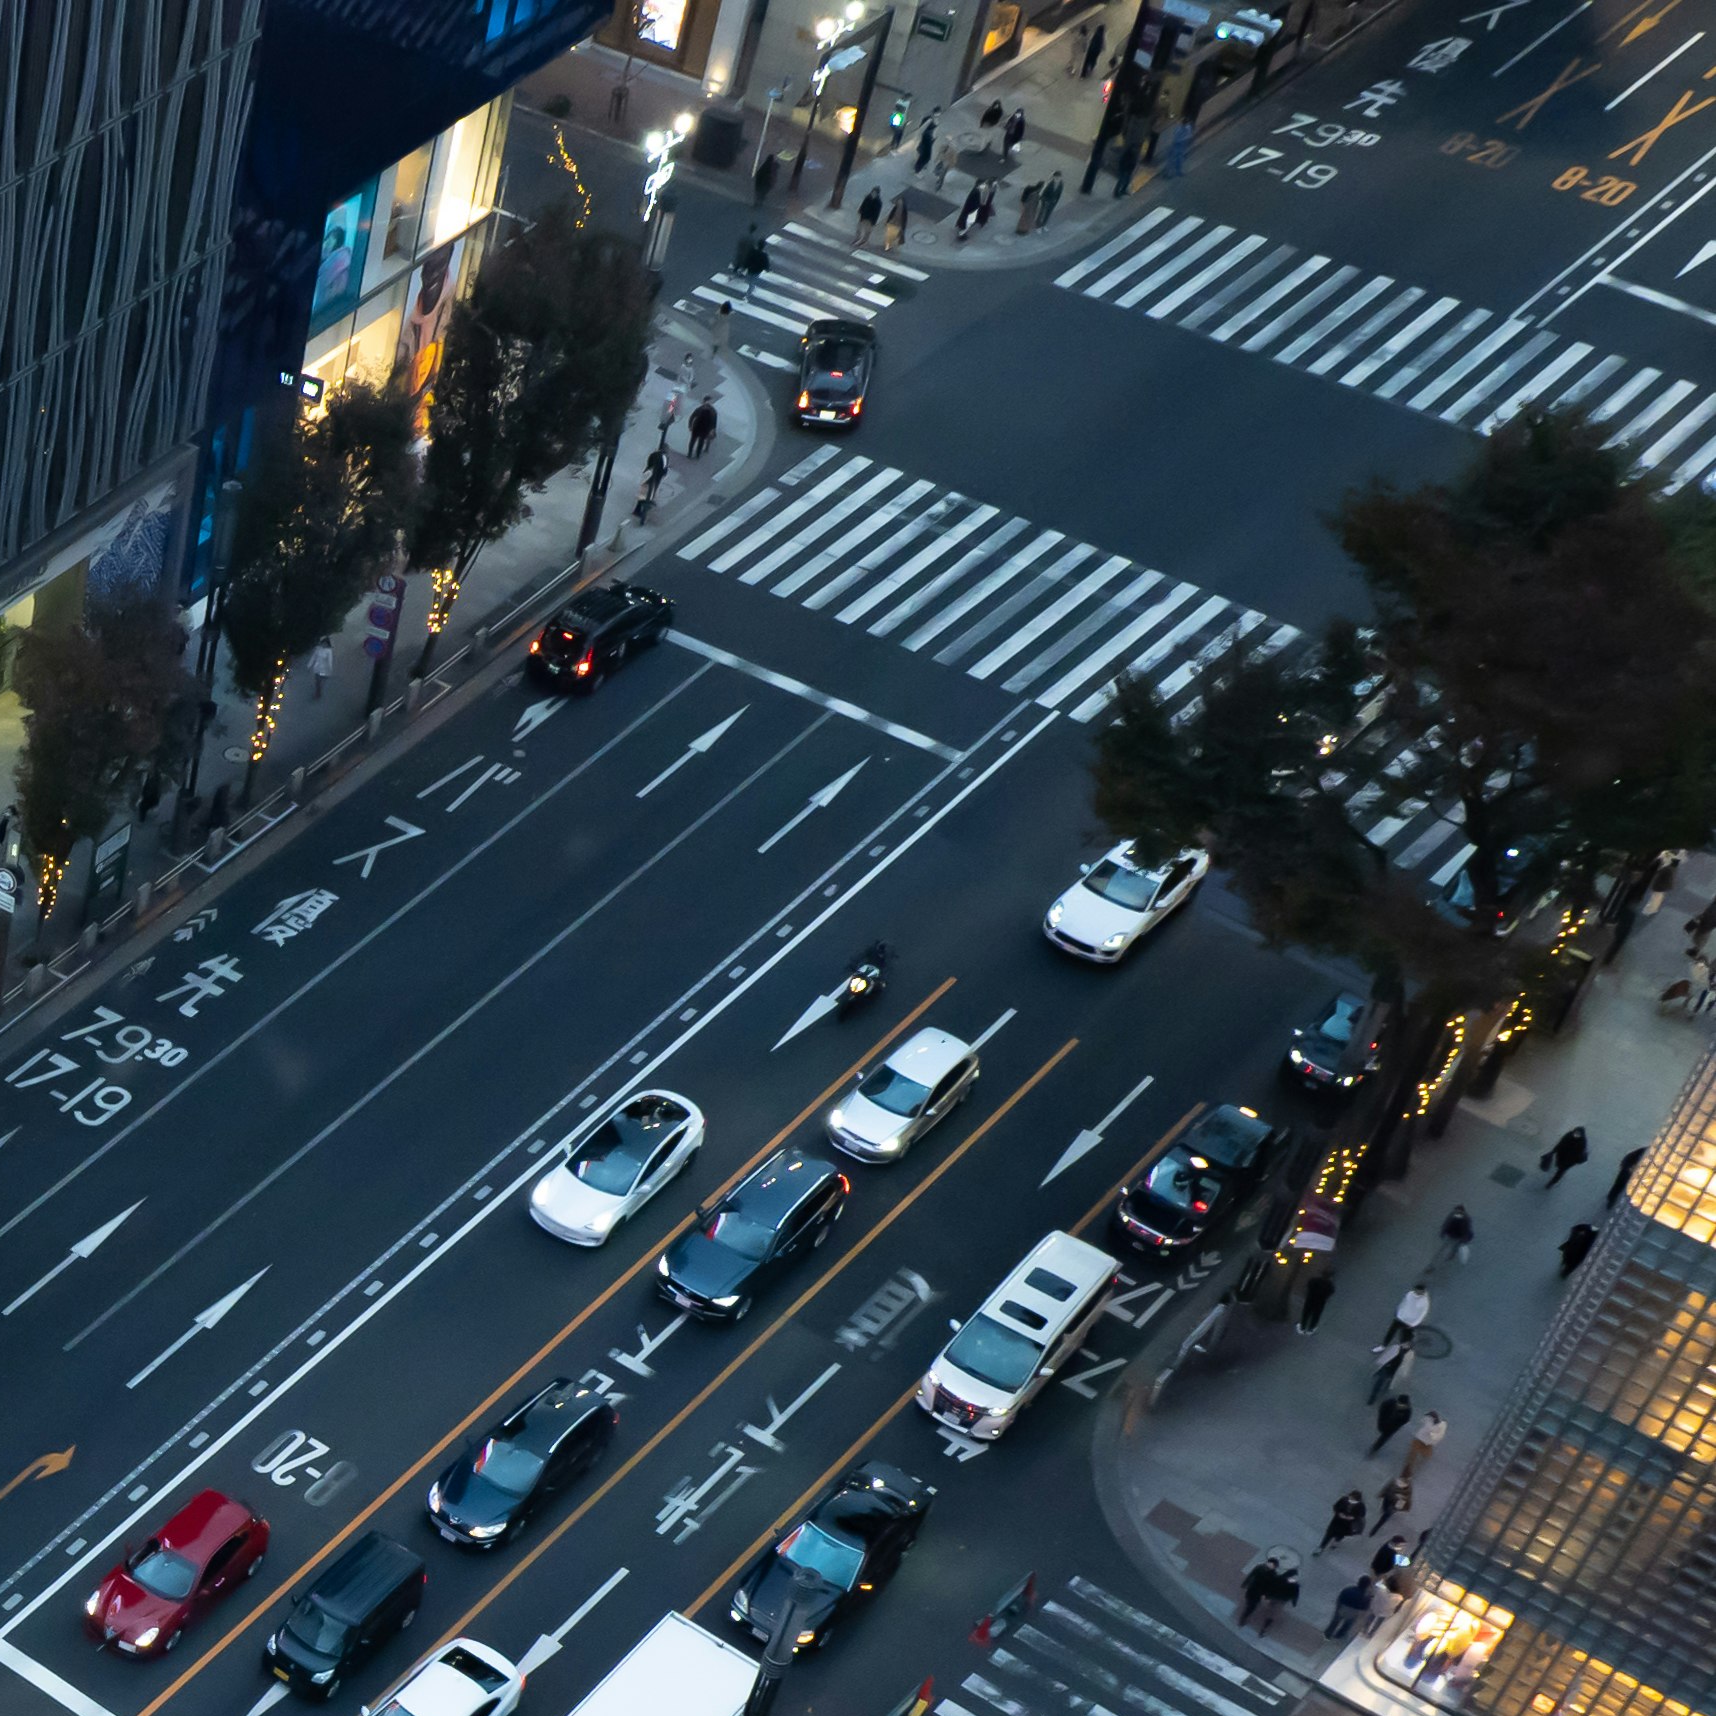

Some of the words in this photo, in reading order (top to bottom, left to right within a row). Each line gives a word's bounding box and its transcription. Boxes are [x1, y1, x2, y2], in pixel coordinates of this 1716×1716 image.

[1227, 145, 1339, 190] 17-19
[1551, 165, 1639, 207] 8-20
[155, 755, 523, 1018] バス優先
[4, 1048, 133, 1127] 17-19
[250, 1427, 359, 1507] 8-20
